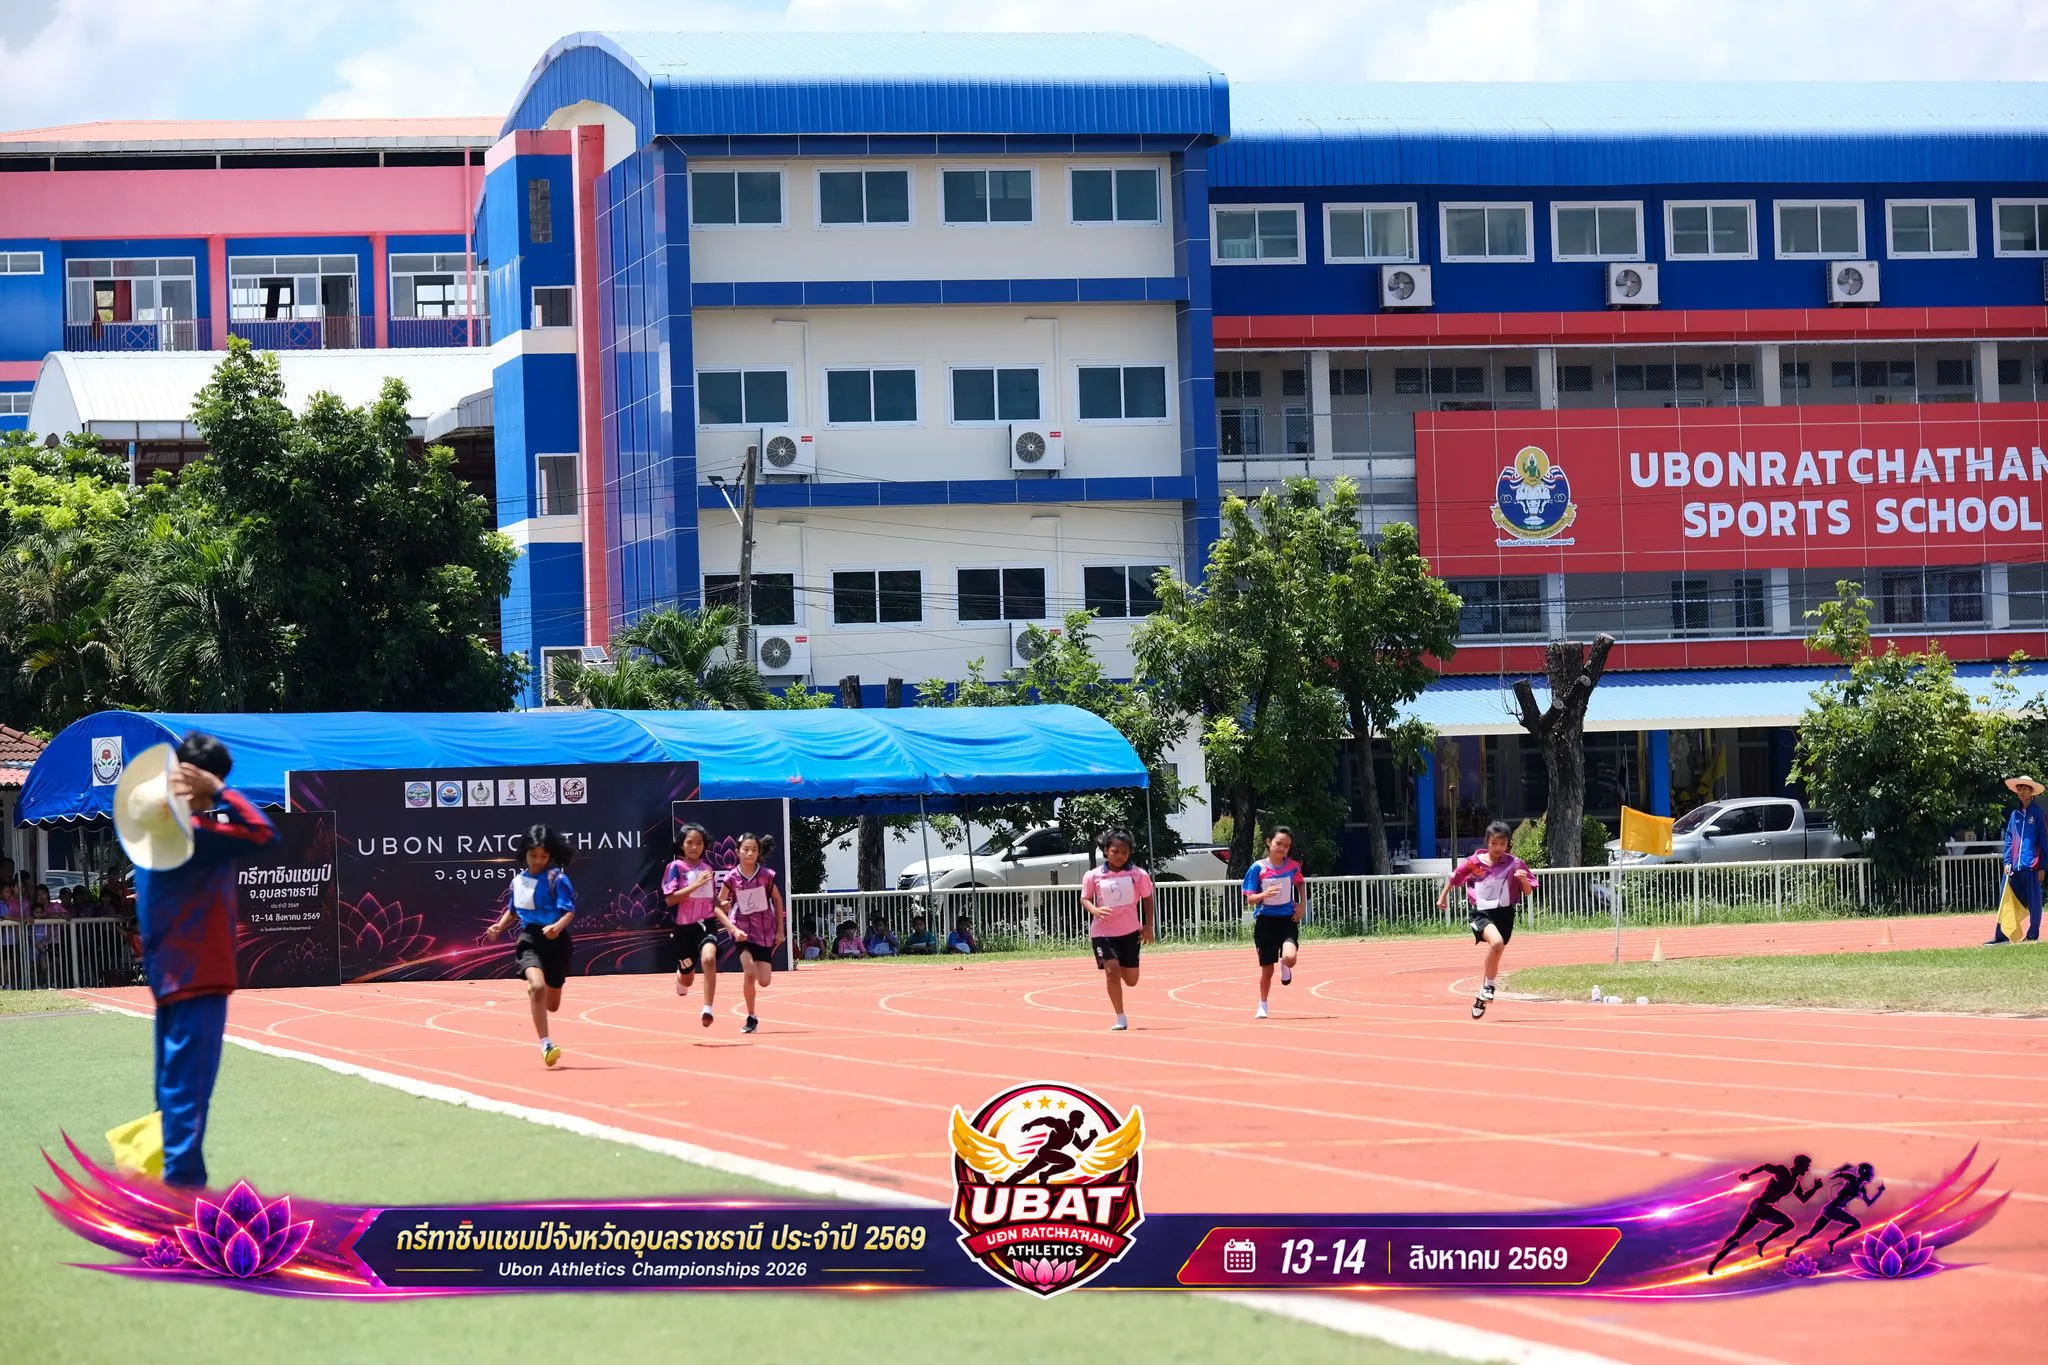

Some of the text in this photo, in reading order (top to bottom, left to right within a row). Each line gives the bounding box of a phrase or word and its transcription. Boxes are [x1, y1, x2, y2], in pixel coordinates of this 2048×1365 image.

[1683, 495, 2043, 538] SPORTS SCHOOL
[358, 830, 642, 856] UBON RATCTHANI
[1110, 882, 1123, 901] 5
[1485, 885, 1498, 902] 2
[275, 912, 301, 922] สิงหาคม
[302, 912, 321, 920] 2569
